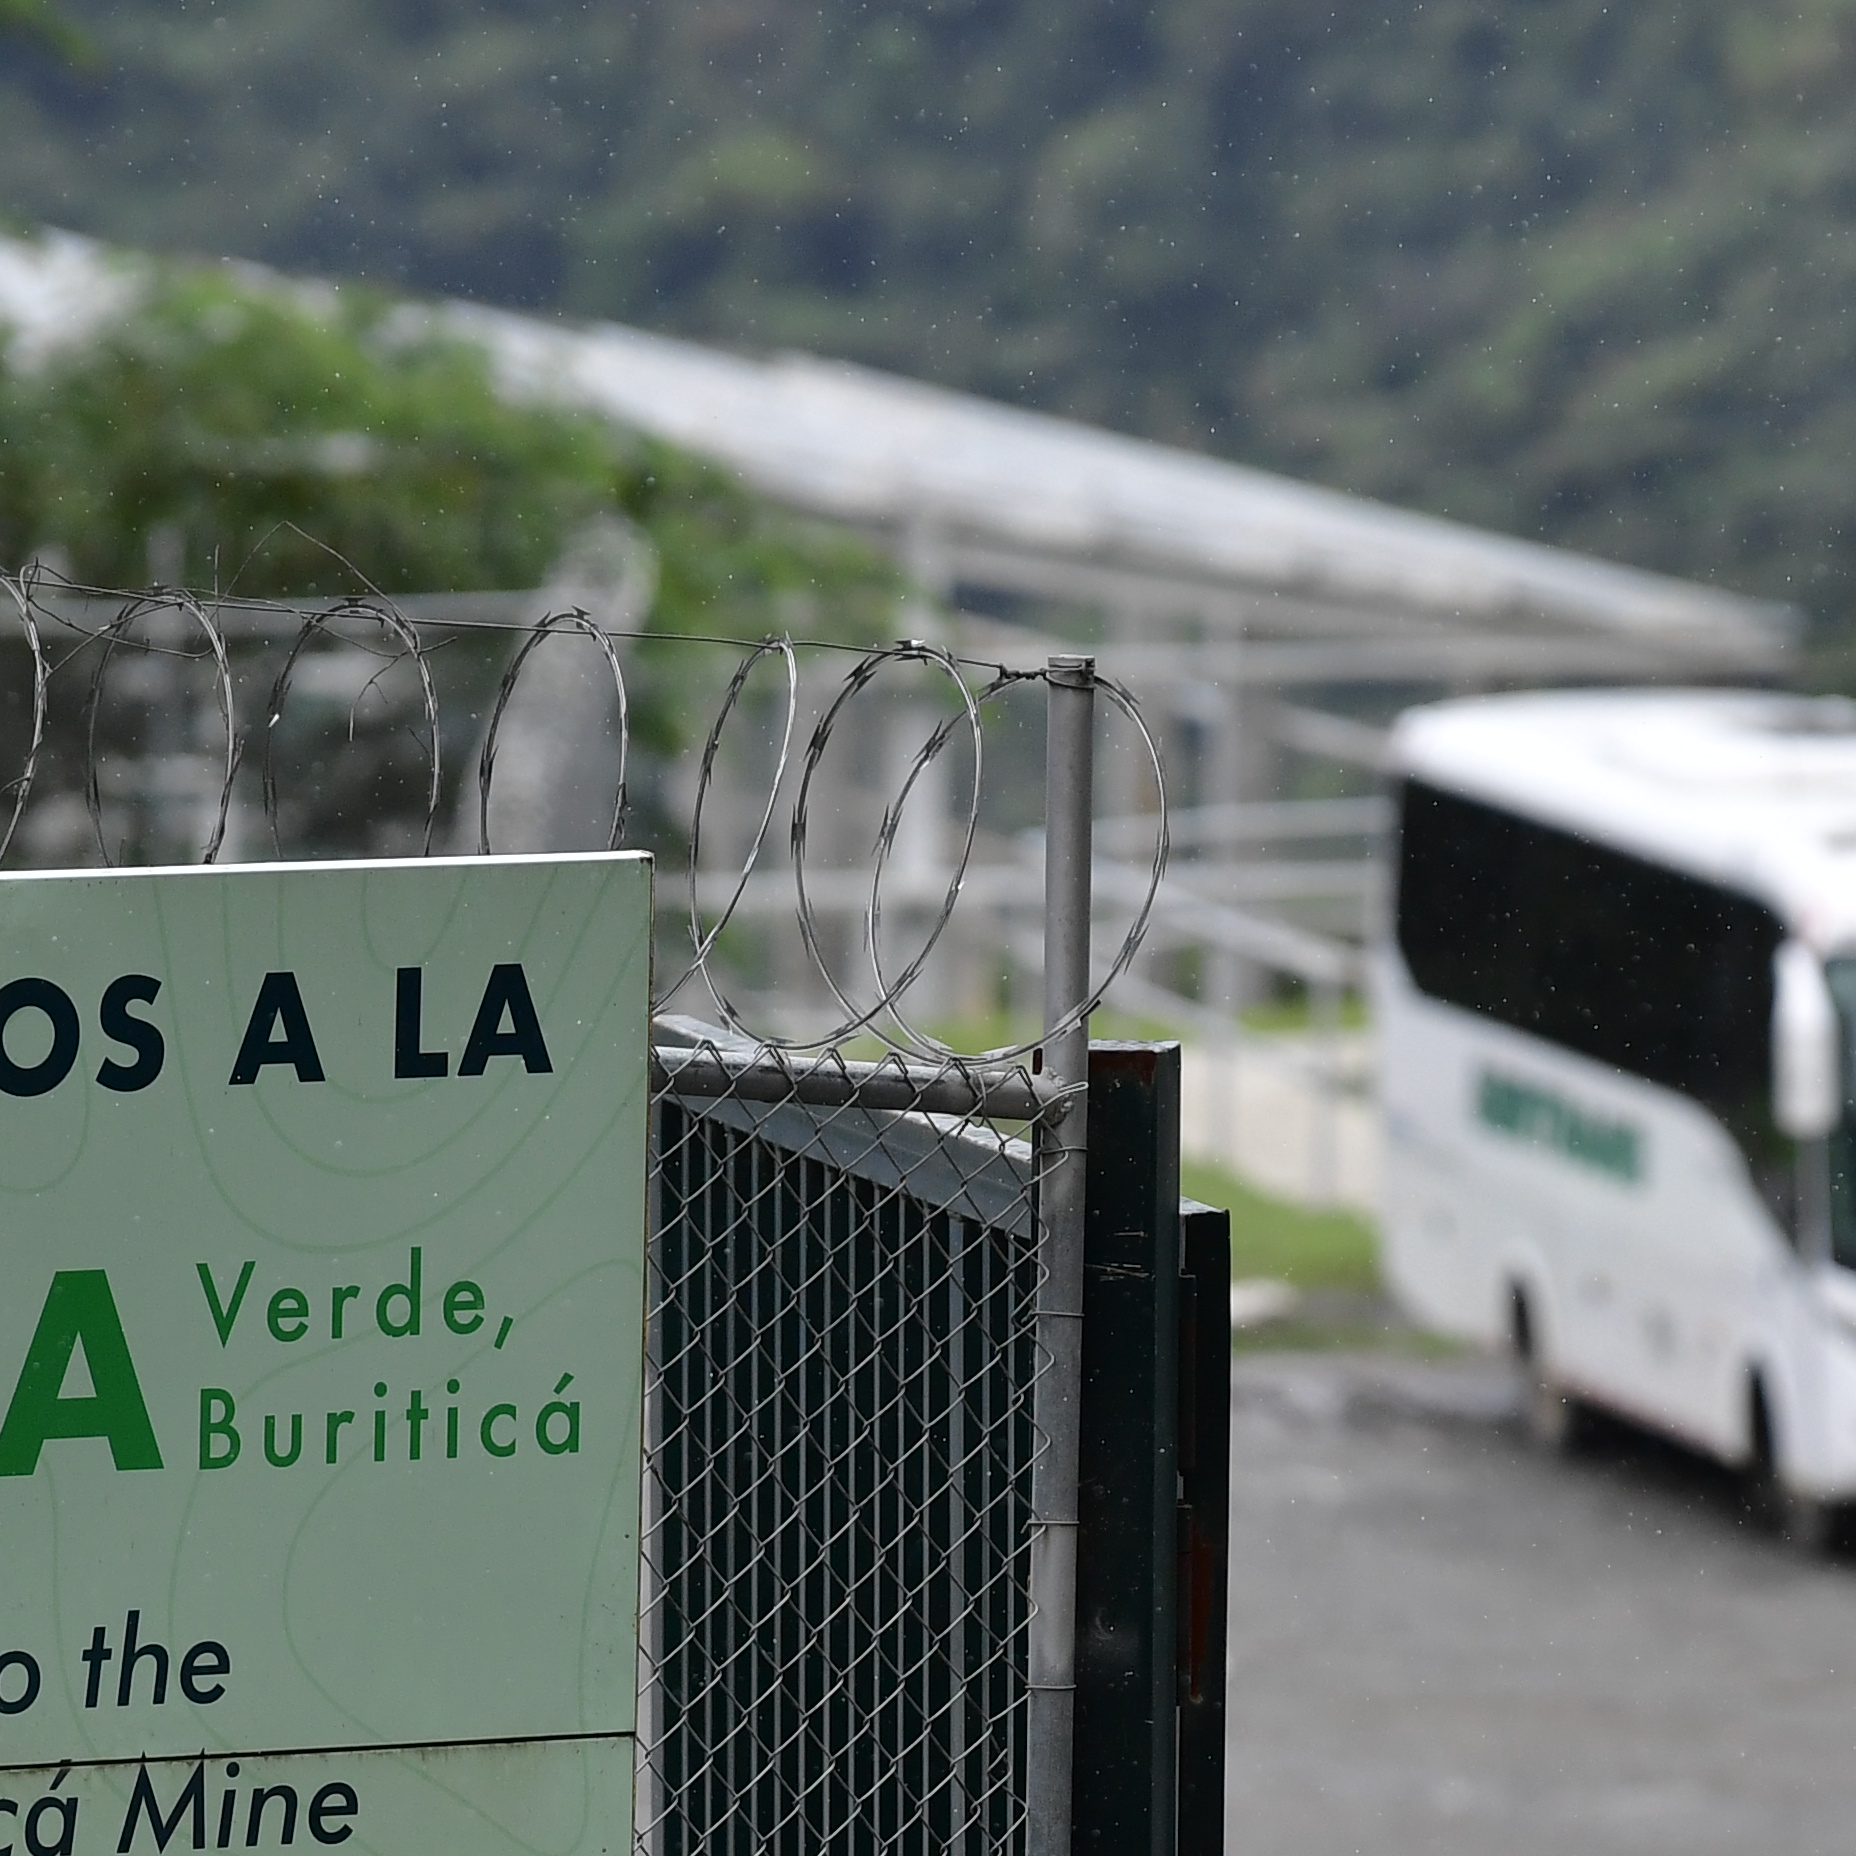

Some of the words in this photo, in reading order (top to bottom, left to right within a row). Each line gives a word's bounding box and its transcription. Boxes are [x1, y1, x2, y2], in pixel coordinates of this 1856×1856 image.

[228, 971, 327, 1086] A
[394, 963, 554, 1080] LA
[195, 1246, 514, 1350] Verde,
[198, 1372, 581, 1471] Buriticá
[81, 1609, 232, 1709] the
[116, 1757, 359, 1855] Mine
